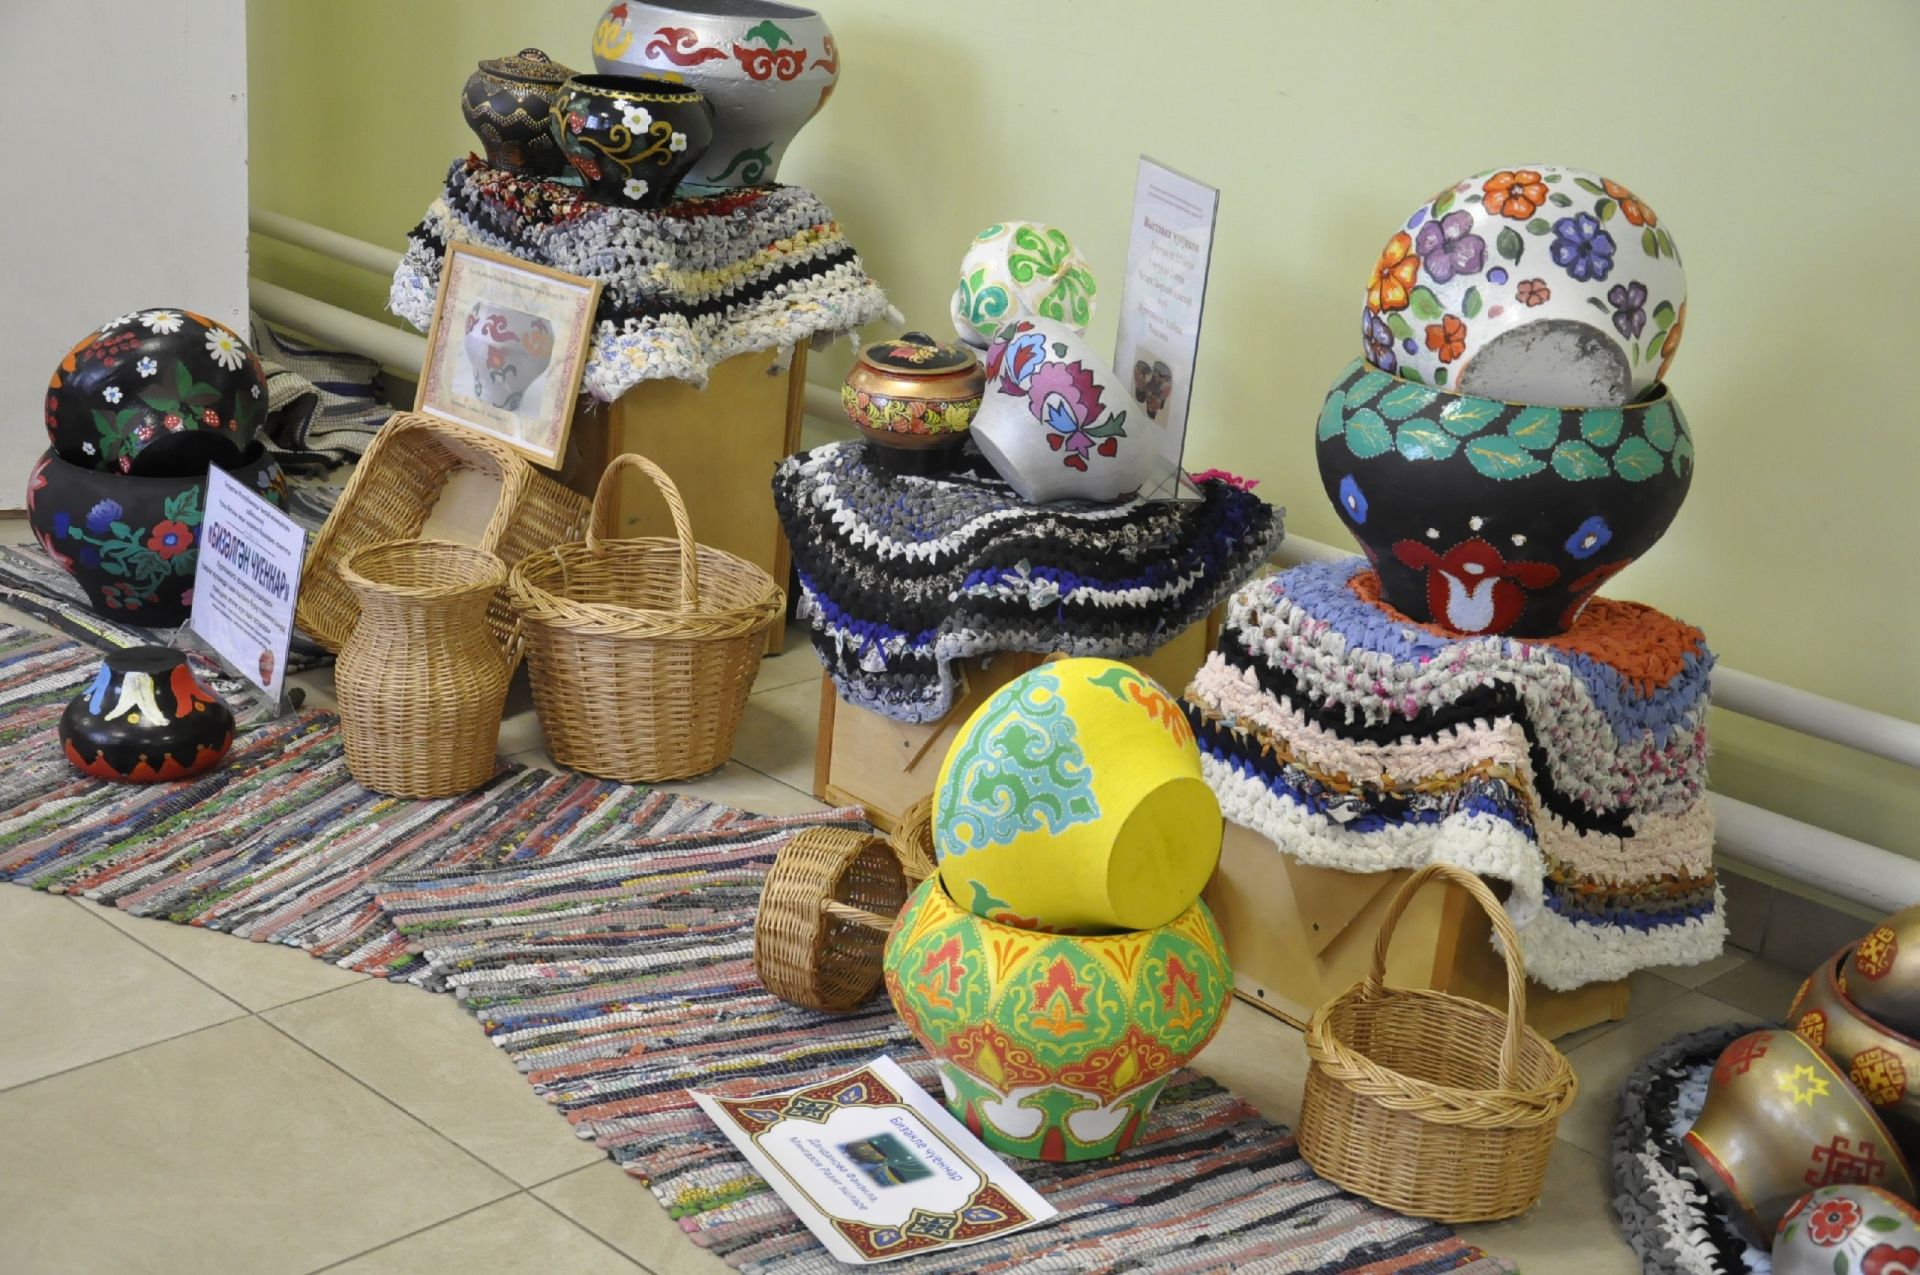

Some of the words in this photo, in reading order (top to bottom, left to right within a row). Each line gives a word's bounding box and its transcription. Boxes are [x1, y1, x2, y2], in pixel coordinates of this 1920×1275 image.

[251, 549, 290, 602] ЧУЕННАР»
[889, 1116, 928, 1150] Бизәкле
[924, 1148, 963, 1182] чуеннар
